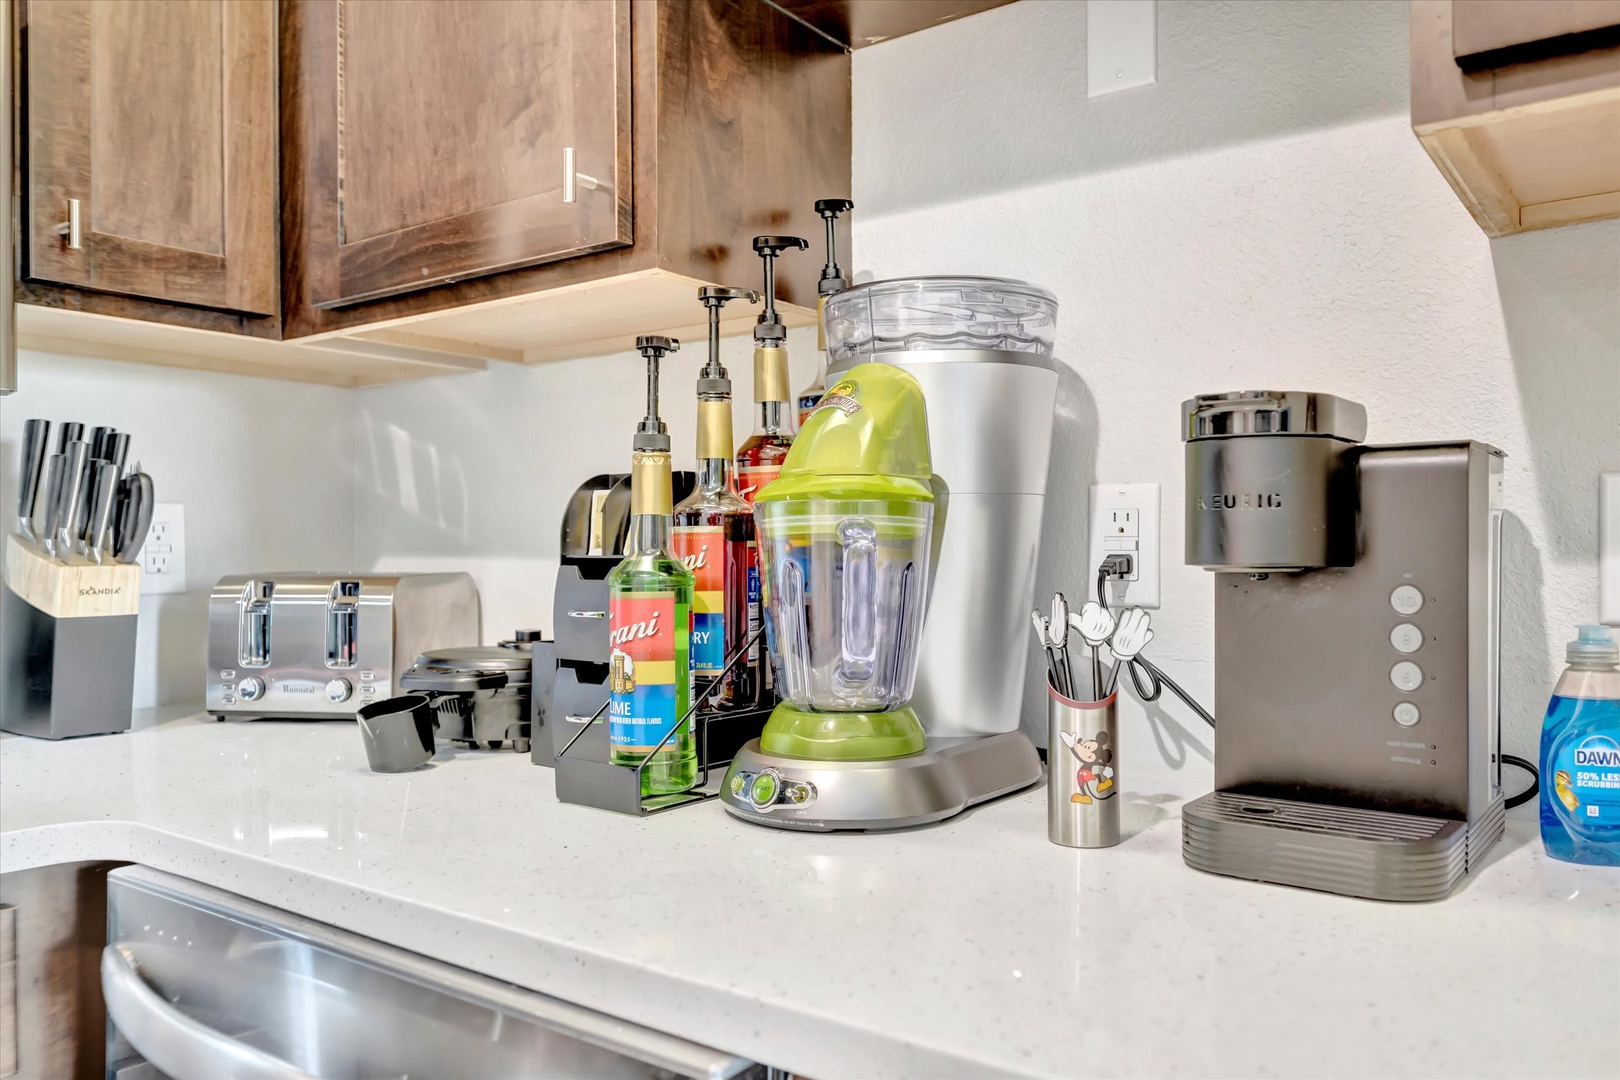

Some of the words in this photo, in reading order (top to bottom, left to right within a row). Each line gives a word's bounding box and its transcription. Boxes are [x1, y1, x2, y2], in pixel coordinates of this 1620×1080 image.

[1198, 494, 1282, 510] KEURIG
[79, 586, 120, 596] SKANDIA
[282, 684, 315, 694] Runnatal
[1576, 751, 1620, 766] DAWN
[1577, 771, 1599, 781] 50%
[1601, 772, 1620, 782] LES
[1577, 780, 1620, 788] SCRUBBIN
